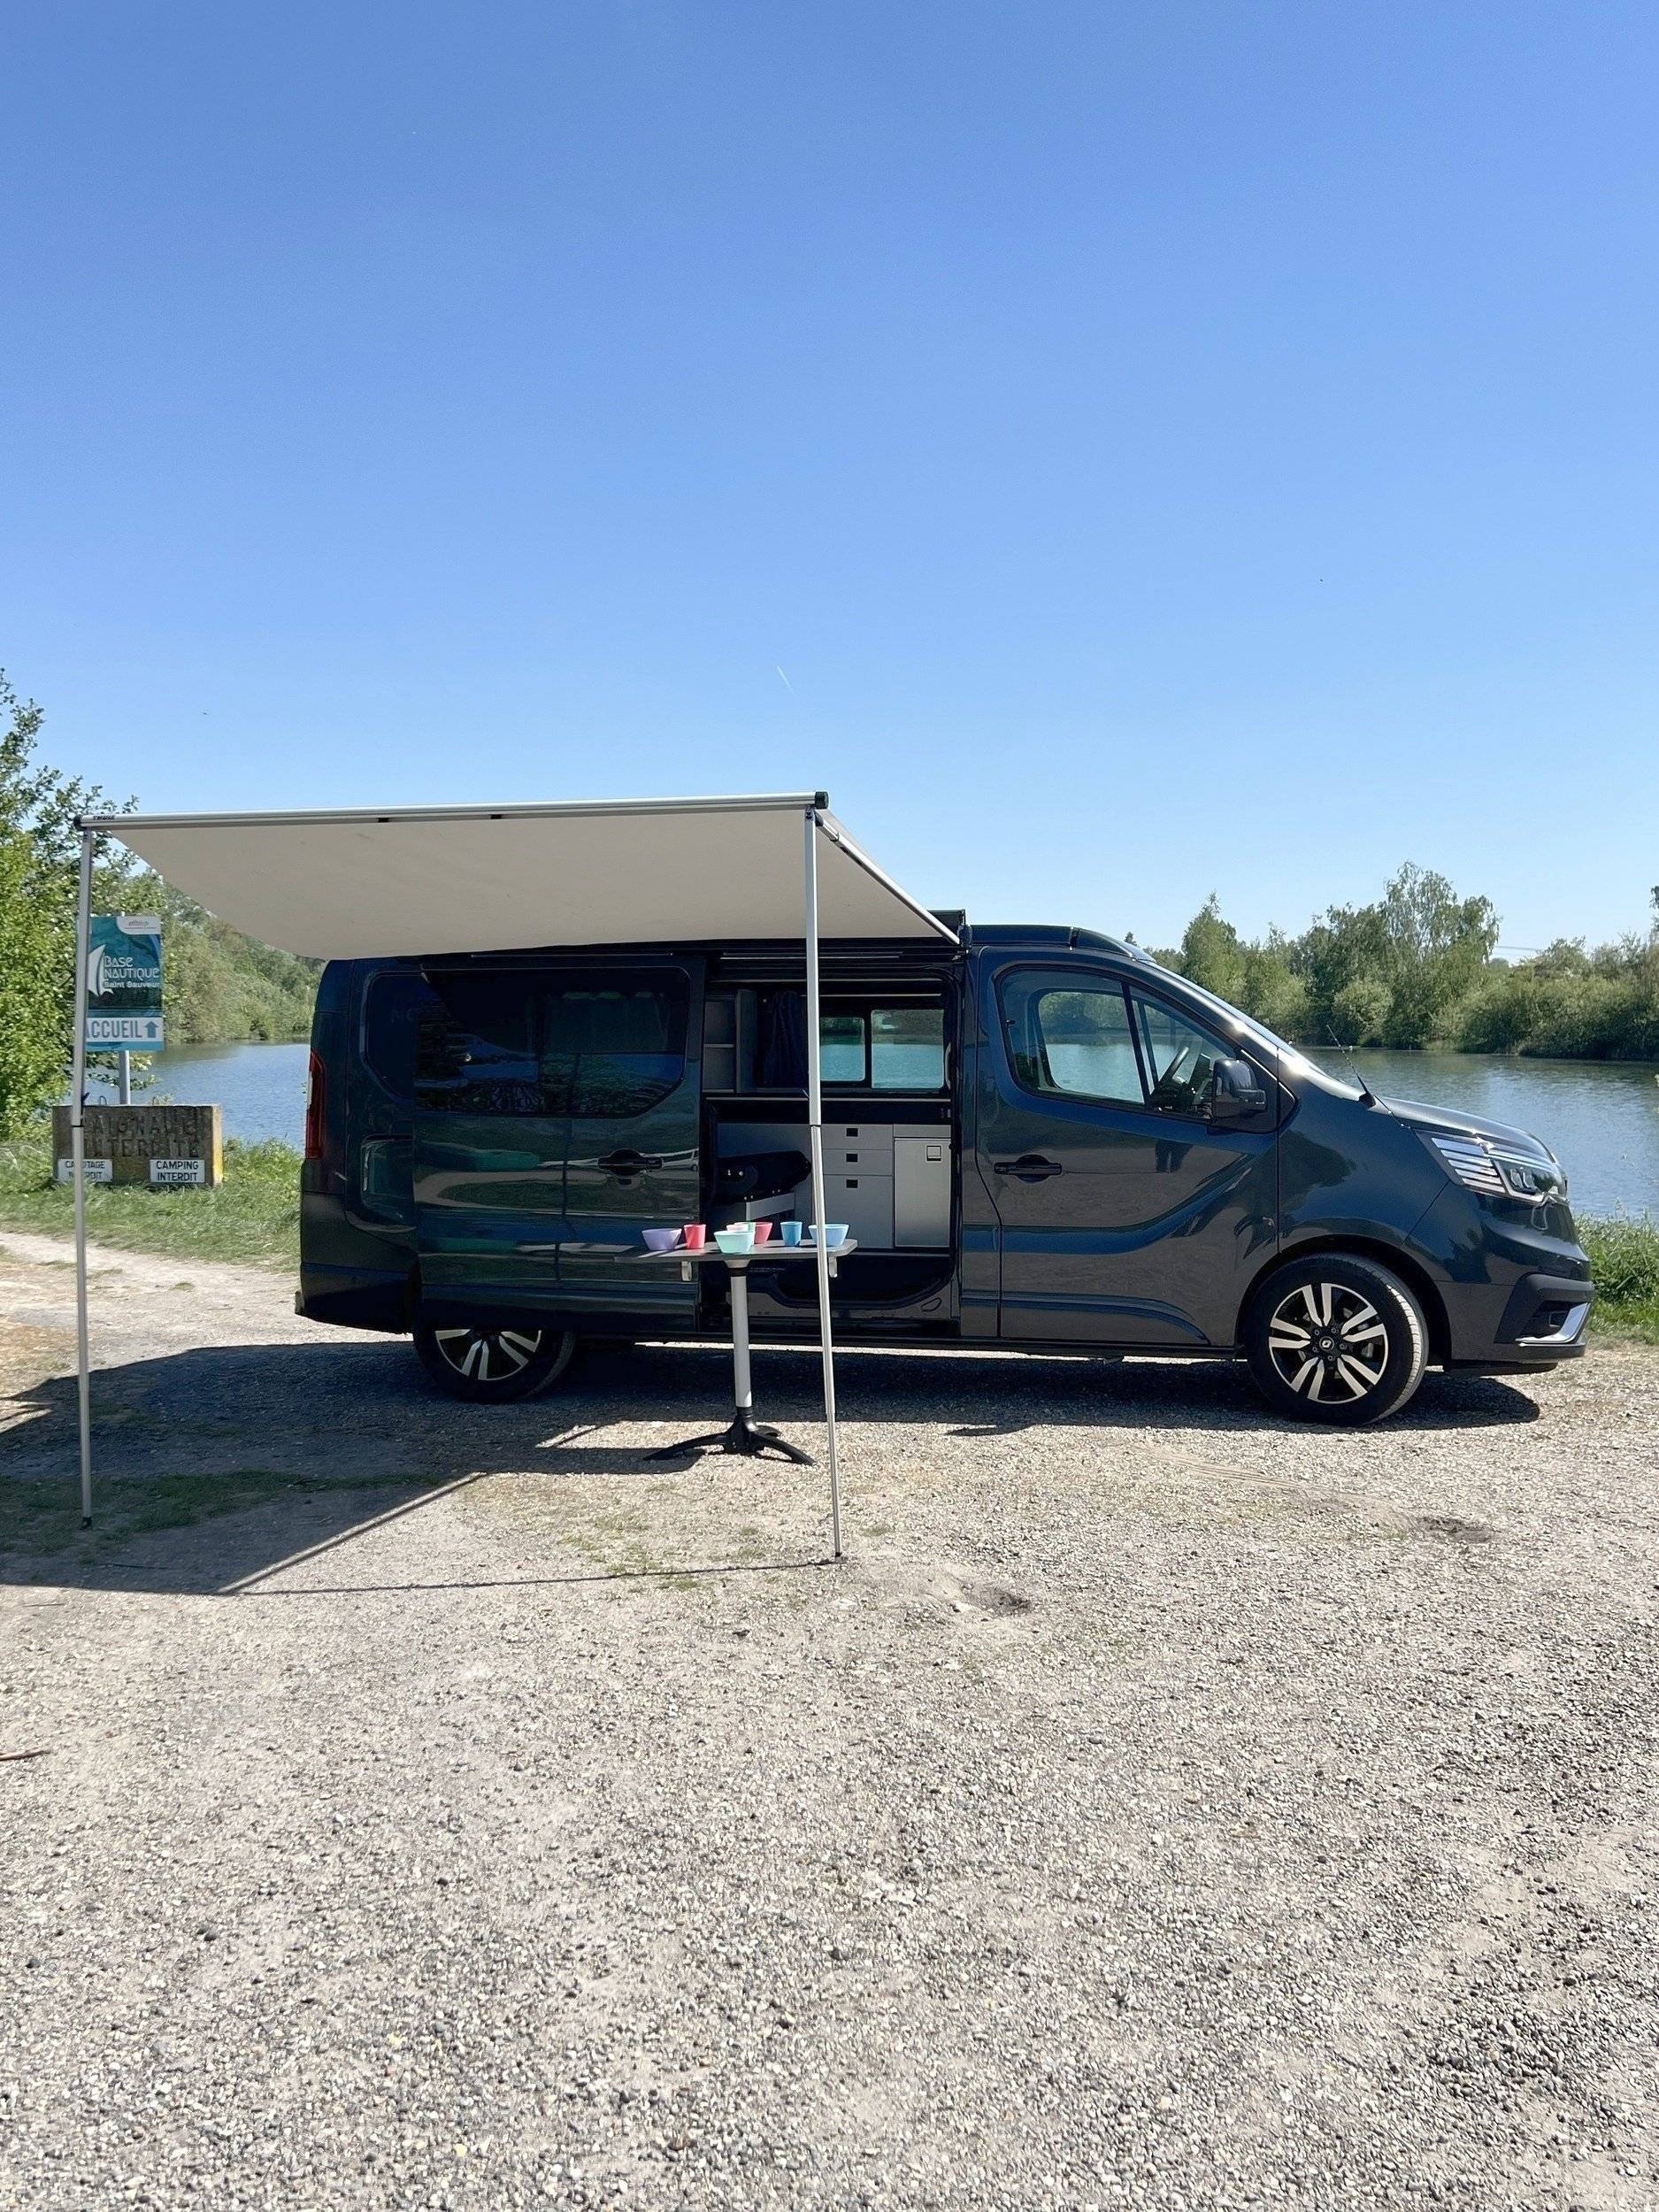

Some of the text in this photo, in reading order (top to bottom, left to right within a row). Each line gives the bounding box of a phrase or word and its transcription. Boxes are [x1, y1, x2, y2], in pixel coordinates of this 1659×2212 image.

[104, 979, 125, 988] Saint
[156, 1161, 199, 1170] CAMPING
[157, 1172, 198, 1181] INTERDIT
